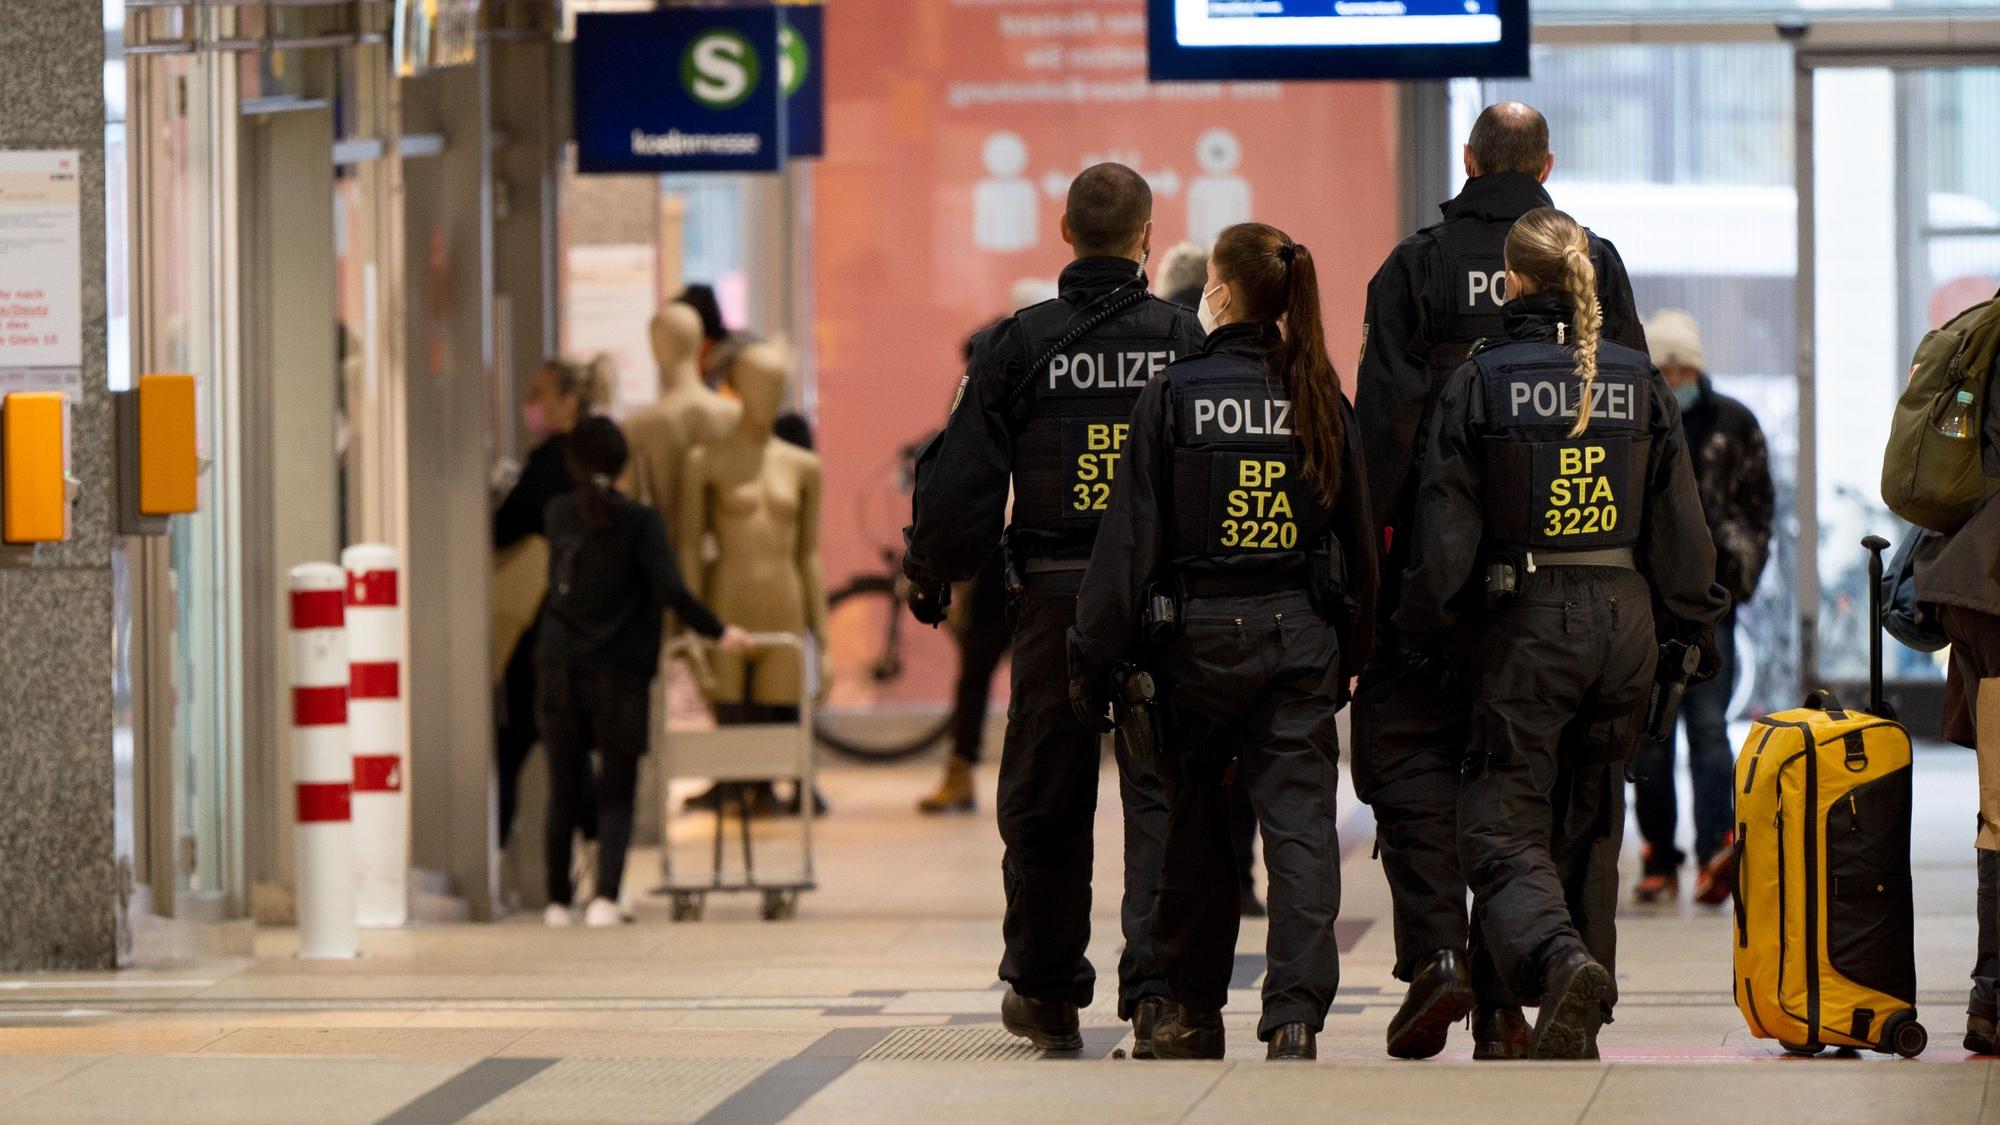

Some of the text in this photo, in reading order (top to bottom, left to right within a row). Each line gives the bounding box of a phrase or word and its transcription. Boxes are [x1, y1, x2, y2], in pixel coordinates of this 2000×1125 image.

[692, 35, 748, 102] S
[1469, 271, 1505, 306] PO
[1510, 381, 1634, 420] POLIZEI
[1195, 399, 1291, 435] POLIZ
[1088, 424, 1129, 450] BP
[1077, 453, 1120, 480] ST
[1240, 460, 1286, 487] BP
[1560, 446, 1605, 475] BP
[1073, 483, 1109, 510] 32
[1228, 490, 1293, 518] STA
[1550, 476, 1614, 506] STA
[1221, 520, 1297, 549] 3220
[1544, 505, 1617, 536] 3220
